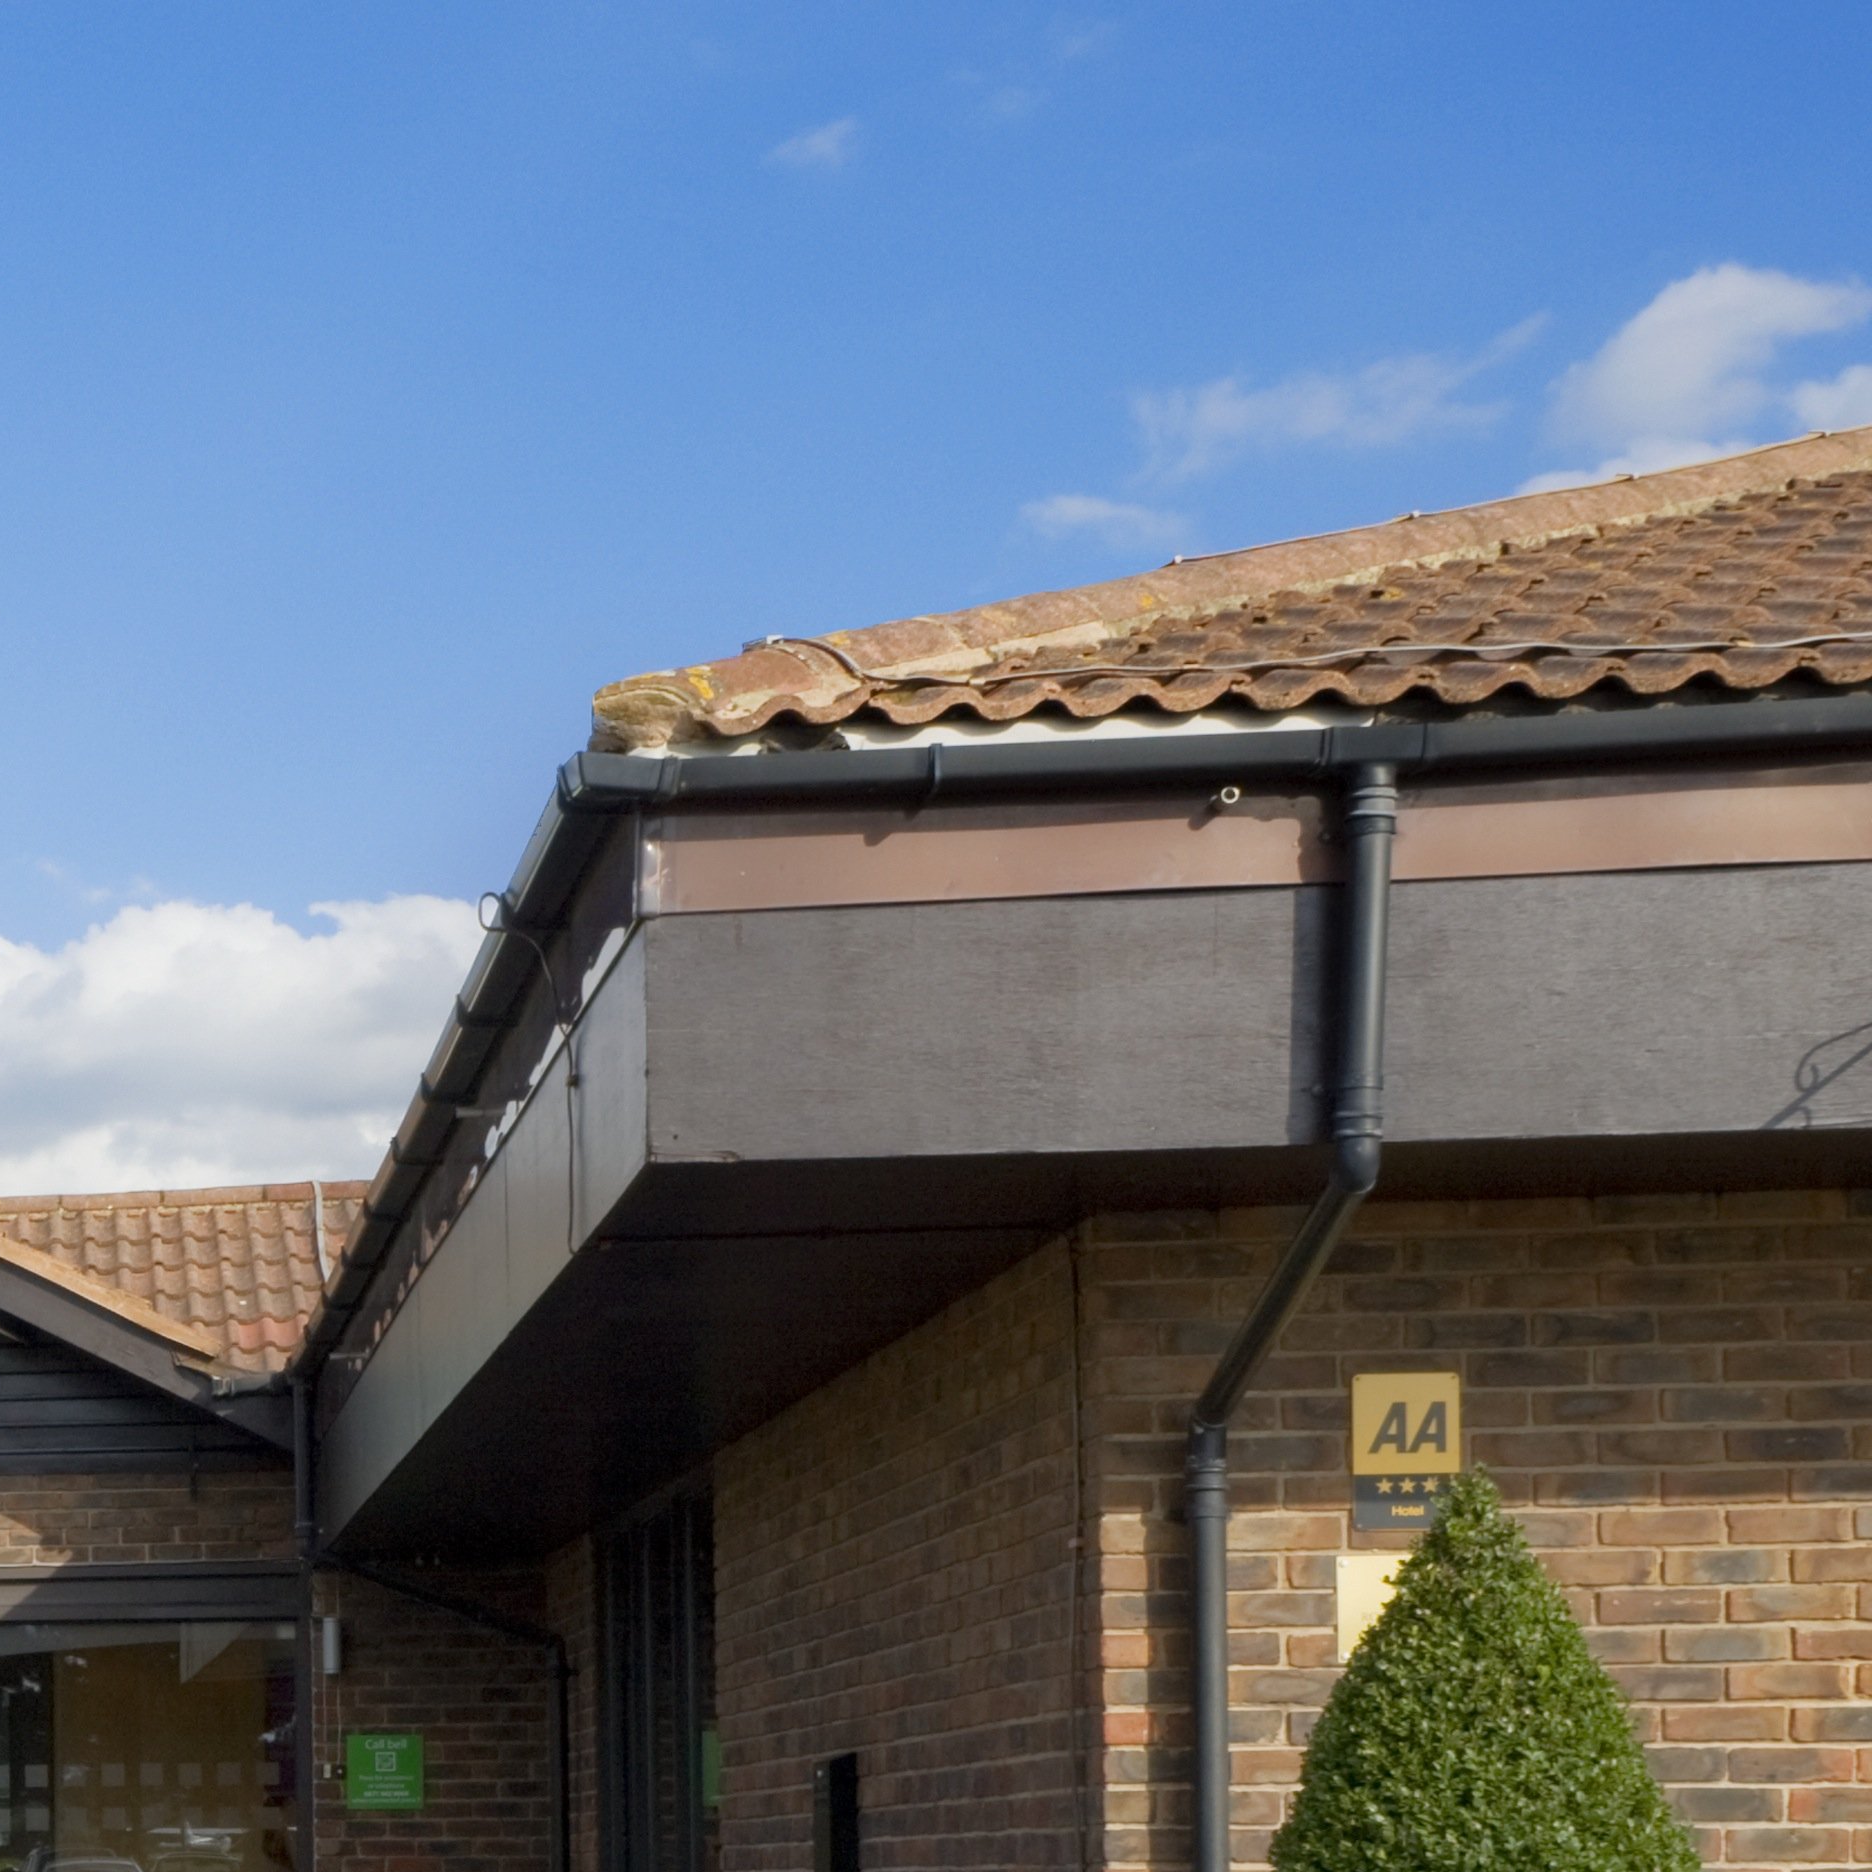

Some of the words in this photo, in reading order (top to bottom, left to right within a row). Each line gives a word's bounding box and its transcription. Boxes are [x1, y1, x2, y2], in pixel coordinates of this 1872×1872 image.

[1368, 1401, 1447, 1454] AA
[1391, 1505, 1425, 1517] Hotel
[365, 1739, 385, 1750] Call
[387, 1738, 407, 1750] bell
